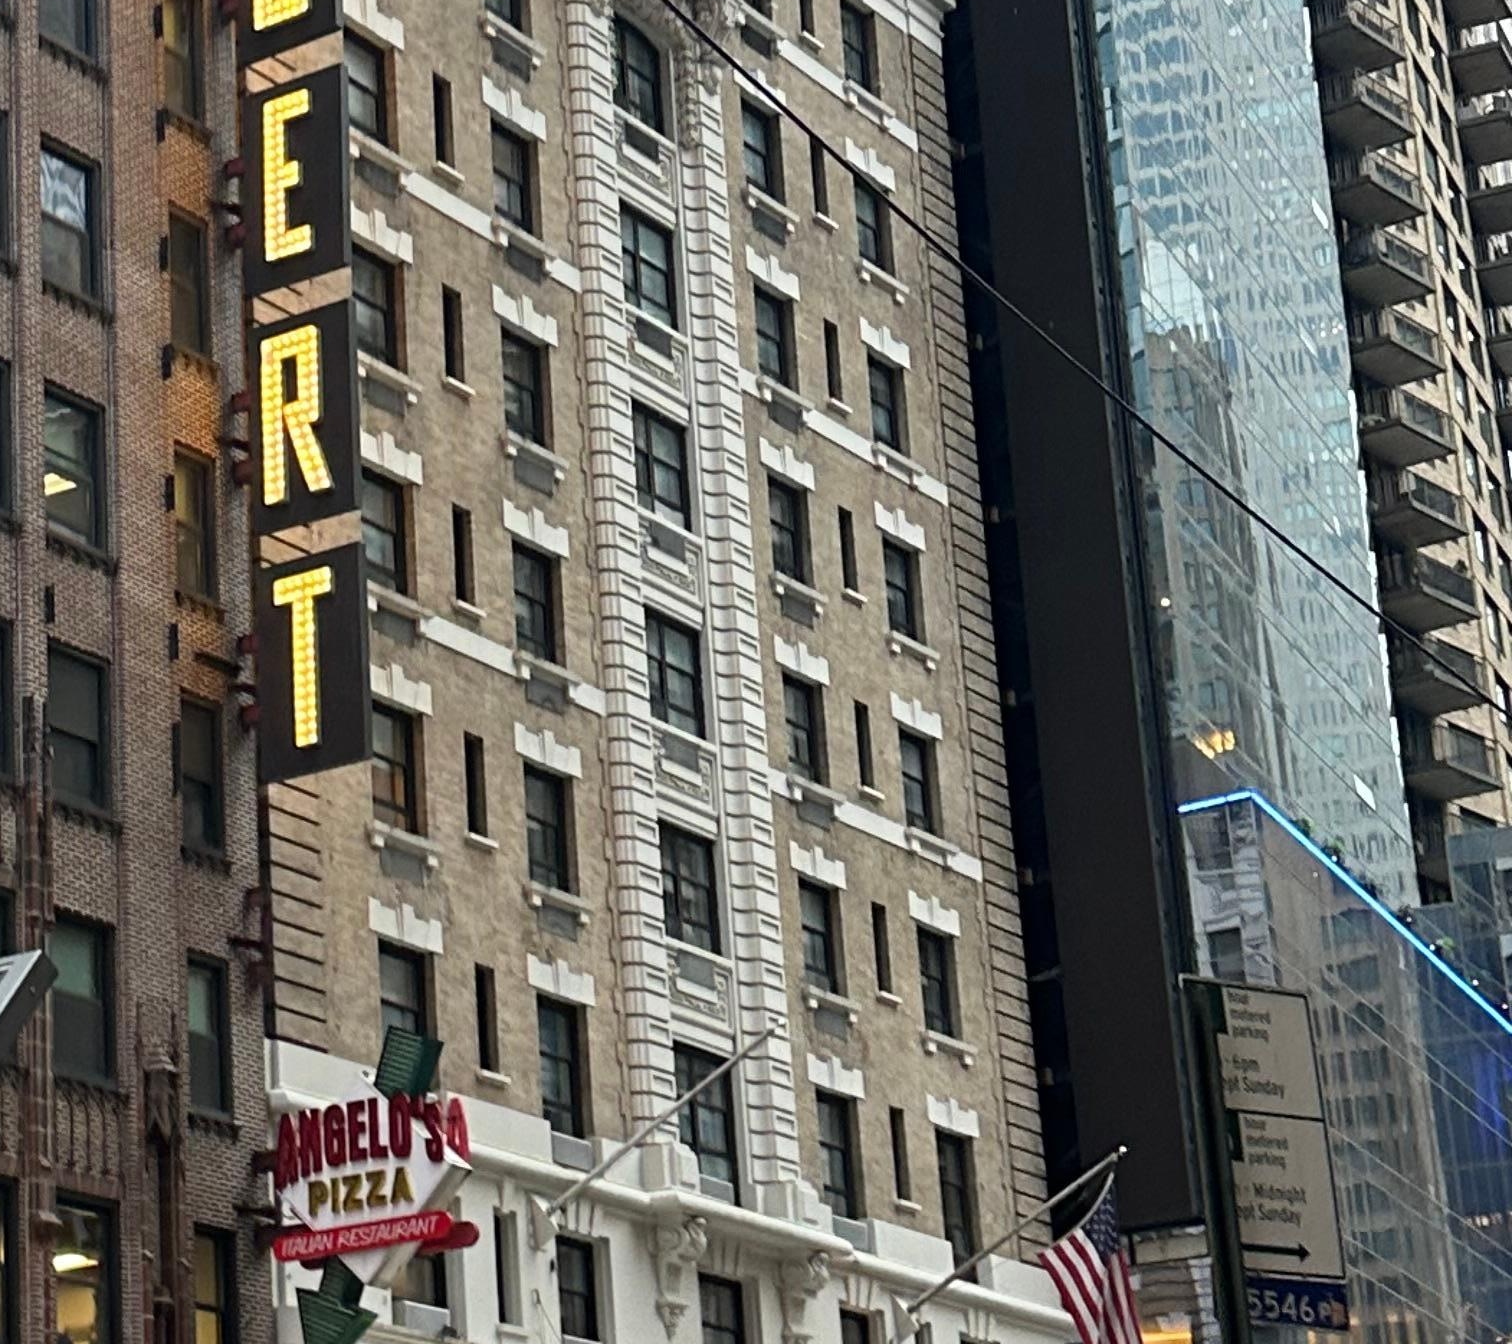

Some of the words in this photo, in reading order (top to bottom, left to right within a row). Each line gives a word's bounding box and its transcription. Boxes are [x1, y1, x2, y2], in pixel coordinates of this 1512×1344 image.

[1230, 1009, 1271, 1025] metered
[1232, 1025, 1270, 1043] parking
[1242, 1076, 1285, 1100] Sunday
[274, 1090, 445, 1194] ANGELO'S
[1245, 1134, 1288, 1151] metered
[1248, 1152, 1286, 1171] parking
[307, 1166, 416, 1217] PIZZA
[1252, 1182, 1307, 1205] Midnight
[1258, 1202, 1301, 1229] Sunday
[281, 1232, 333, 1261] ITALIAN
[337, 1215, 441, 1251] RESTAURANT
